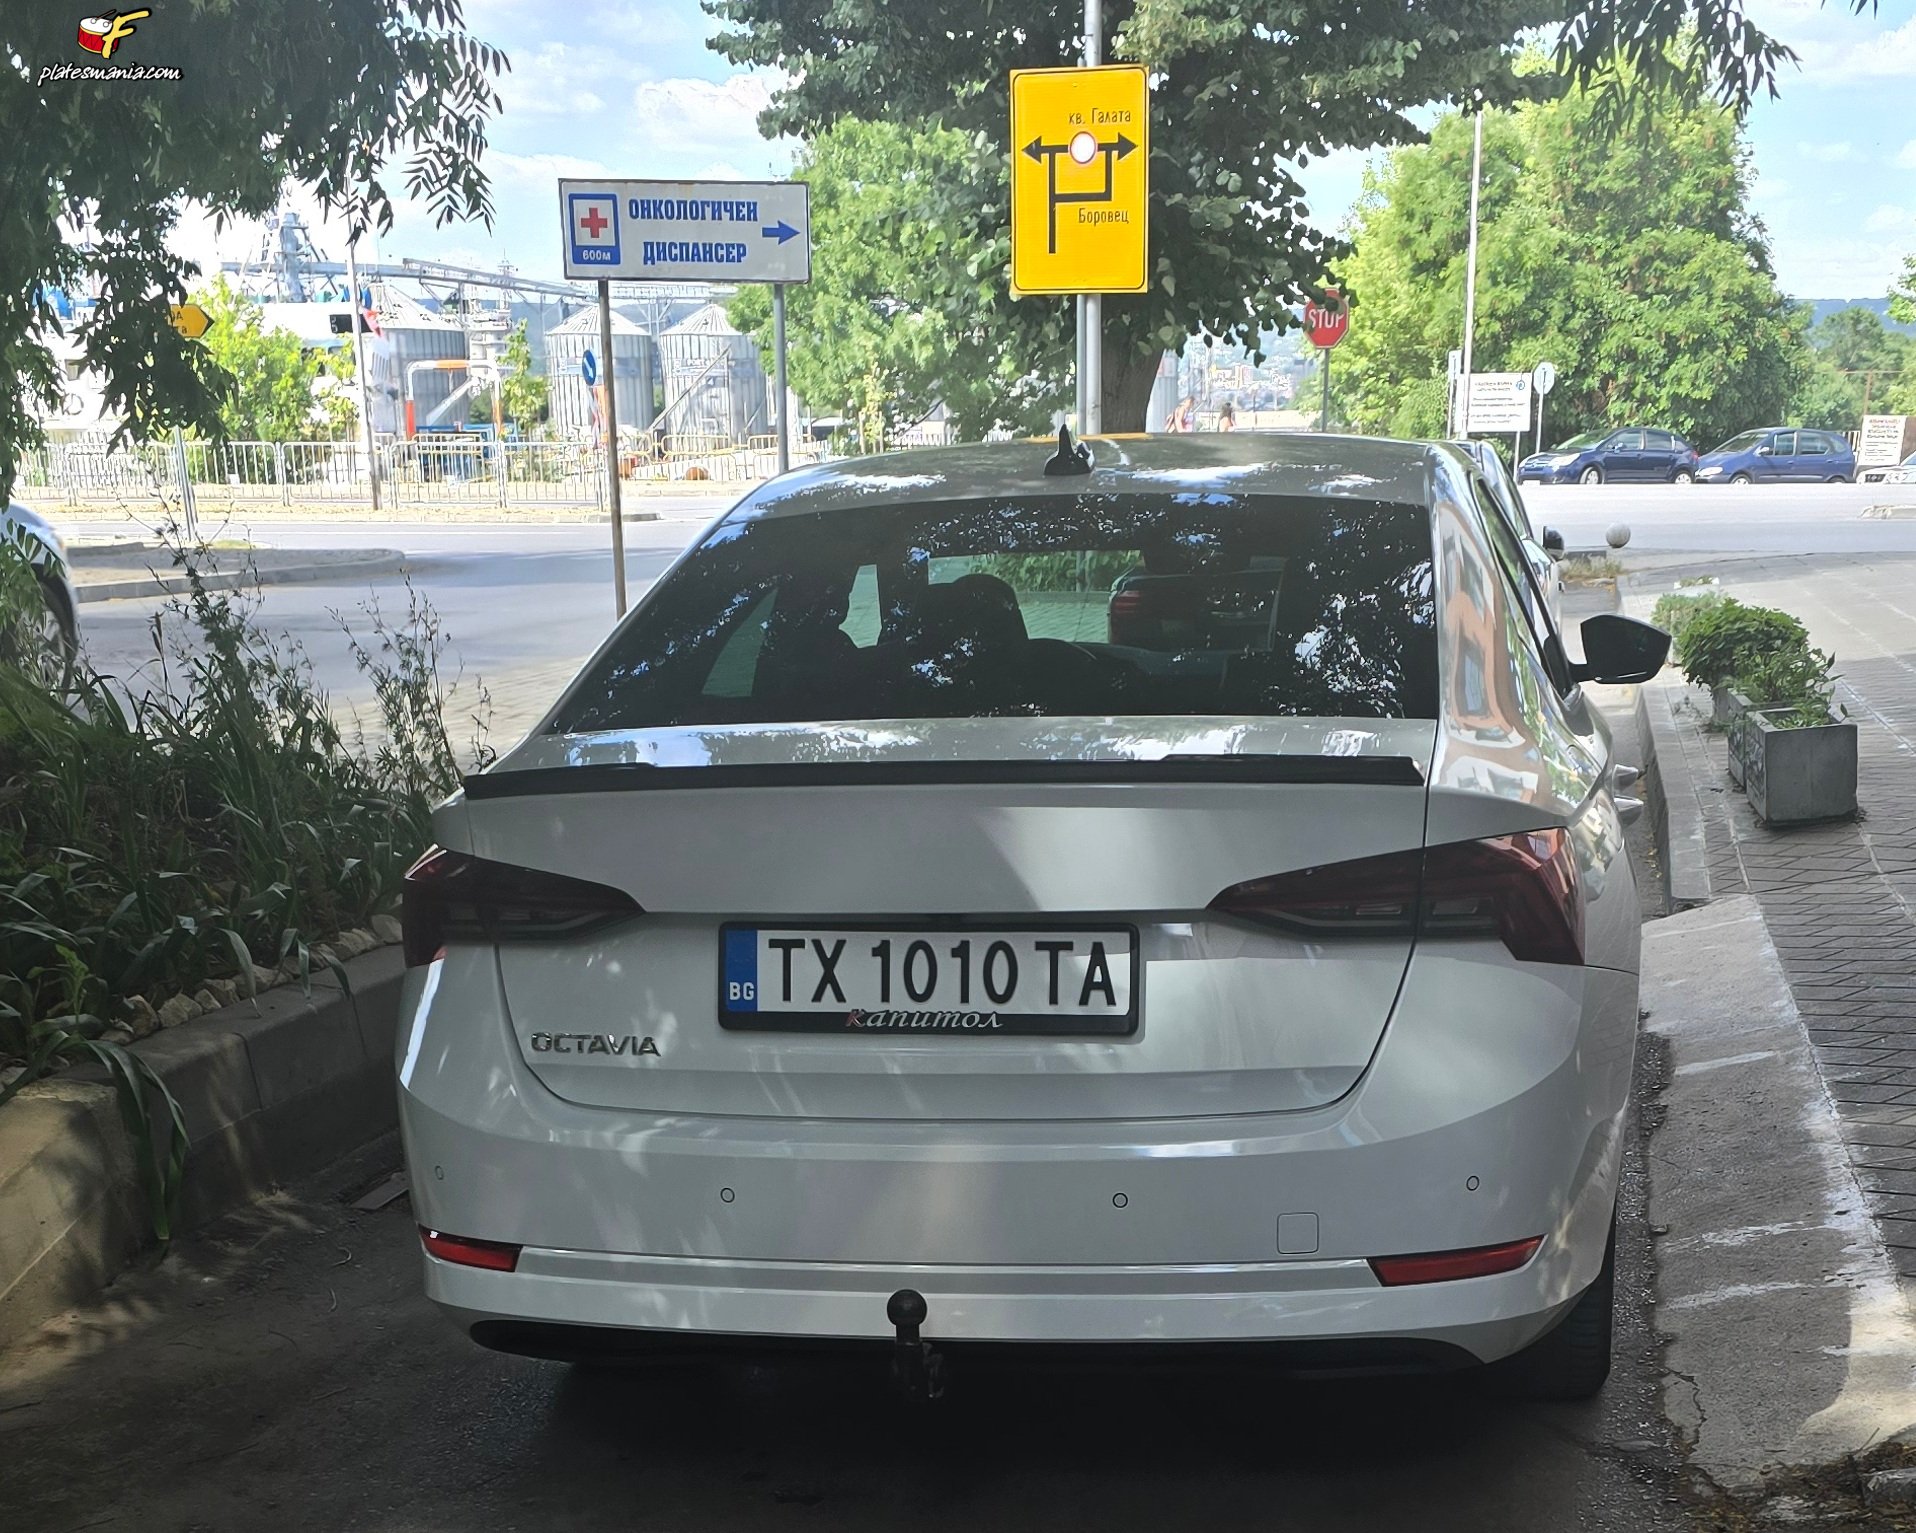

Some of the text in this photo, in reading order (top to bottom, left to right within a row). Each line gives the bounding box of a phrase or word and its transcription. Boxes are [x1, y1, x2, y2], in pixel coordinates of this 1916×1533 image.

[1068, 107, 1131, 125] кв. Галата
[628, 198, 759, 222] ОНКОЛОГИЧЕН
[1078, 207, 1130, 227] Боровец
[643, 241, 748, 266] ДИСПАНСЕР
[871, 939, 1019, 1005] 1010
[1034, 941, 1117, 1007] TA
[729, 981, 755, 1001] BG
[531, 1032, 662, 1057] OCTAVIA
